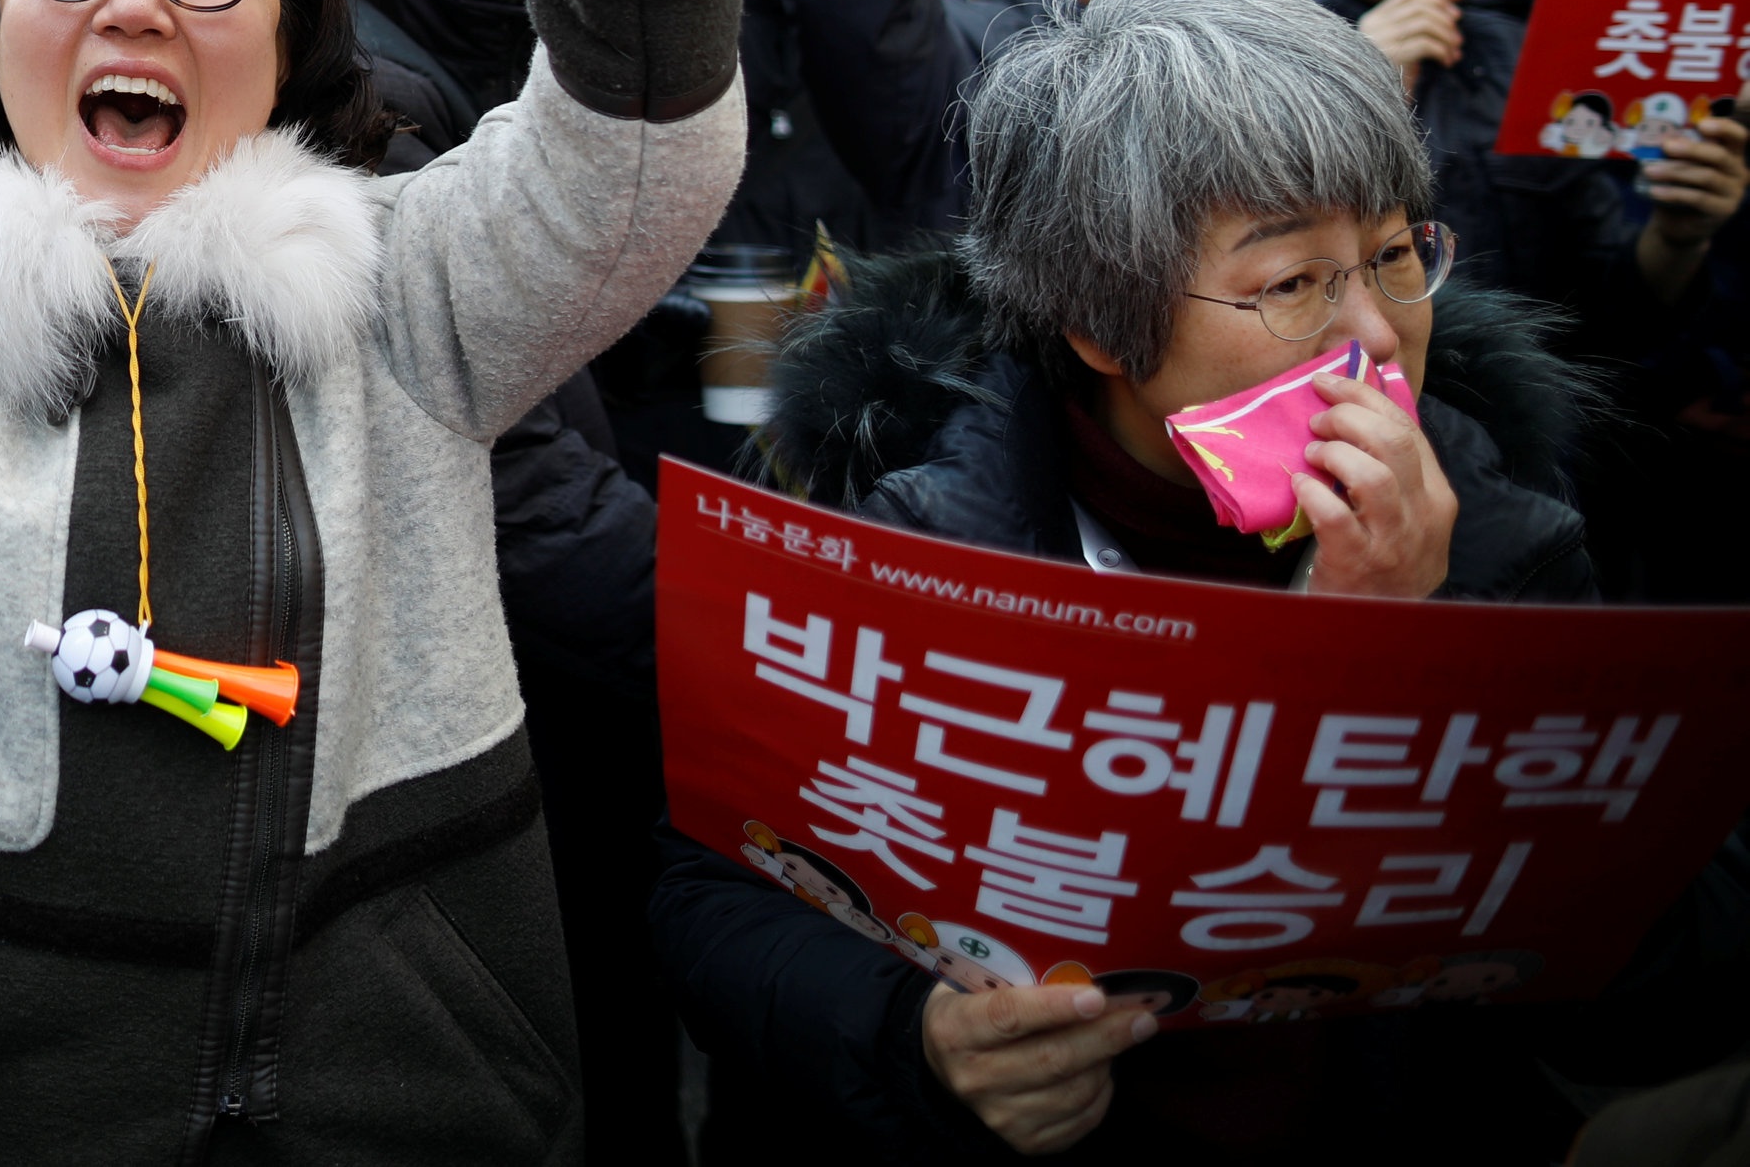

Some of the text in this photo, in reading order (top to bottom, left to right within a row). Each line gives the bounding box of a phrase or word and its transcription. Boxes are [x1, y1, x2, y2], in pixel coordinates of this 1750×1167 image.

[1593, 0, 1734, 82] 촛불
[696, 493, 1196, 641] 나눔문화 www.nanum.com
[742, 592, 1681, 830] 박근혜 탄핵
[798, 754, 1533, 953] 촛불 승리
